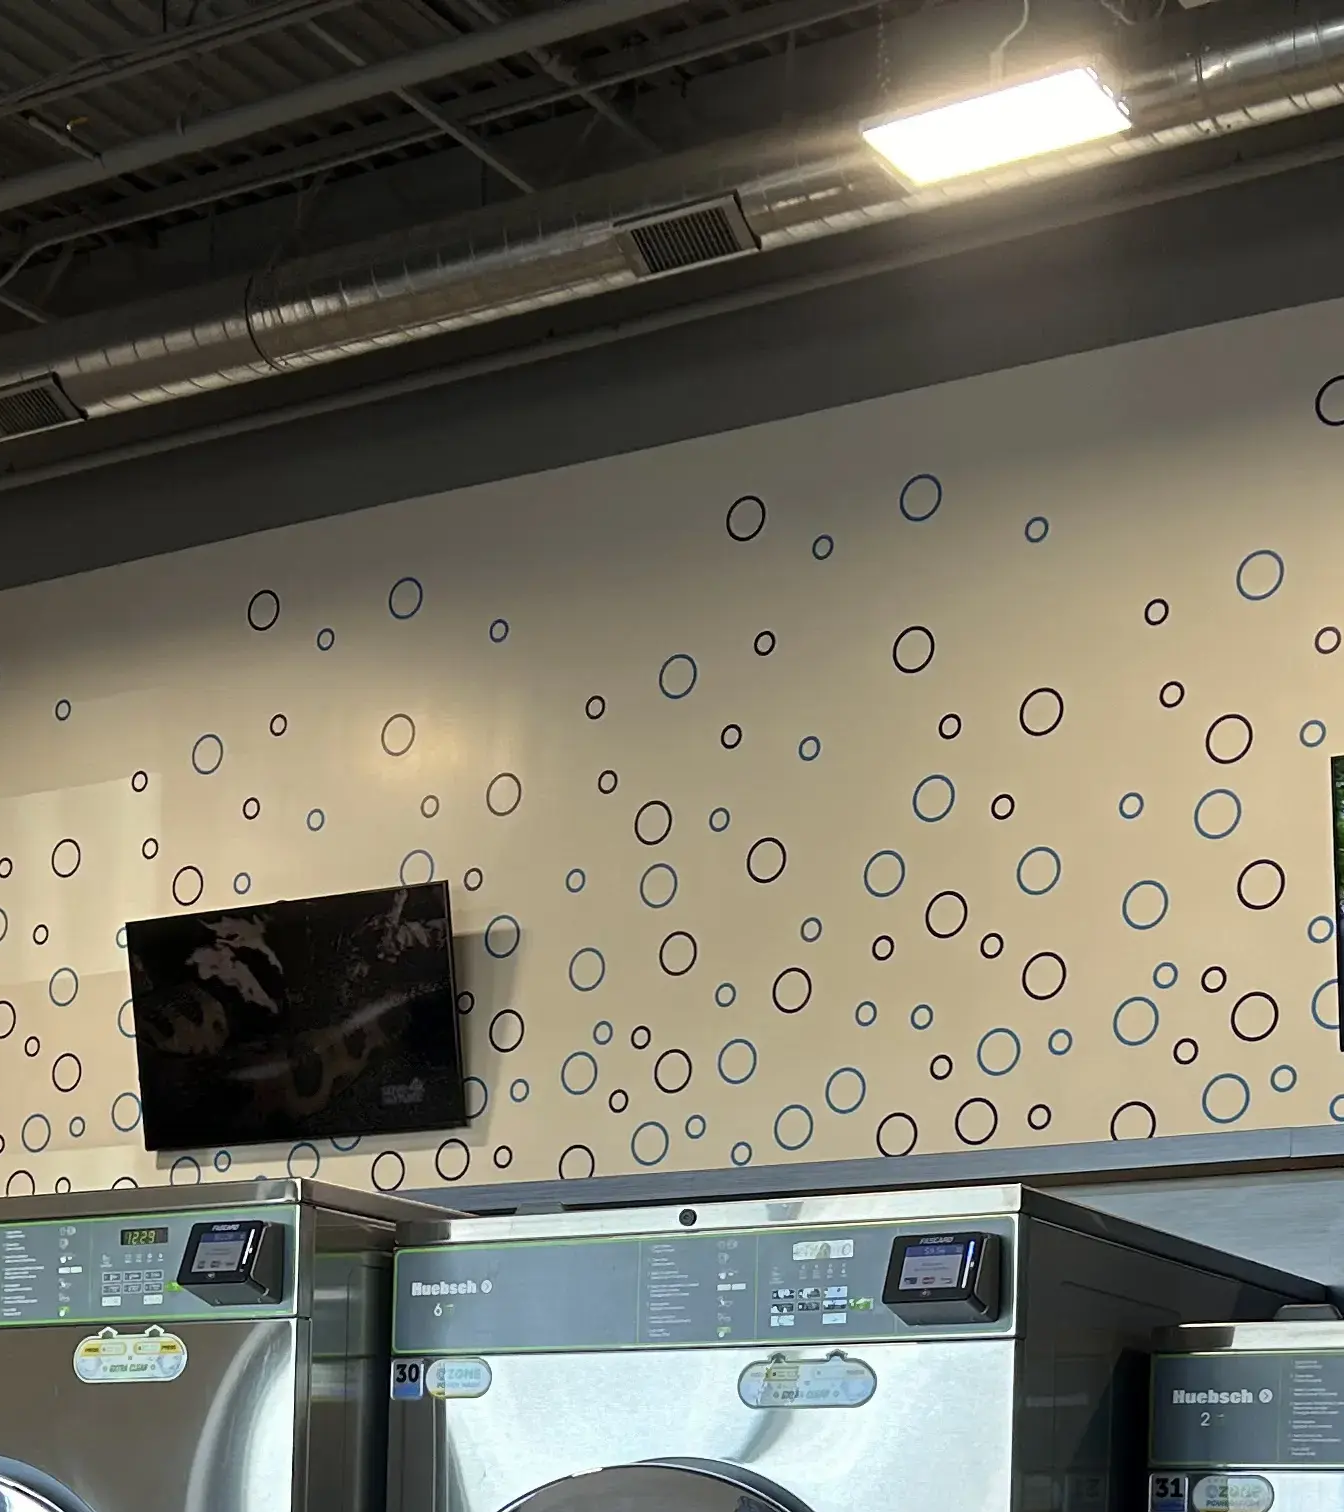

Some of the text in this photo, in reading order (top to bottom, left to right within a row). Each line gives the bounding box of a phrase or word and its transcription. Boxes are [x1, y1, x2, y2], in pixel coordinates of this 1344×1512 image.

[127, 1230, 155, 1245] 1229
[411, 1280, 477, 1296] Huebsch
[433, 1303, 443, 1317] 6
[395, 1364, 419, 1383] 30
[1172, 1389, 1253, 1404] Huebsch
[1200, 1412, 1210, 1426] 2
[1155, 1478, 1184, 1498] 31
